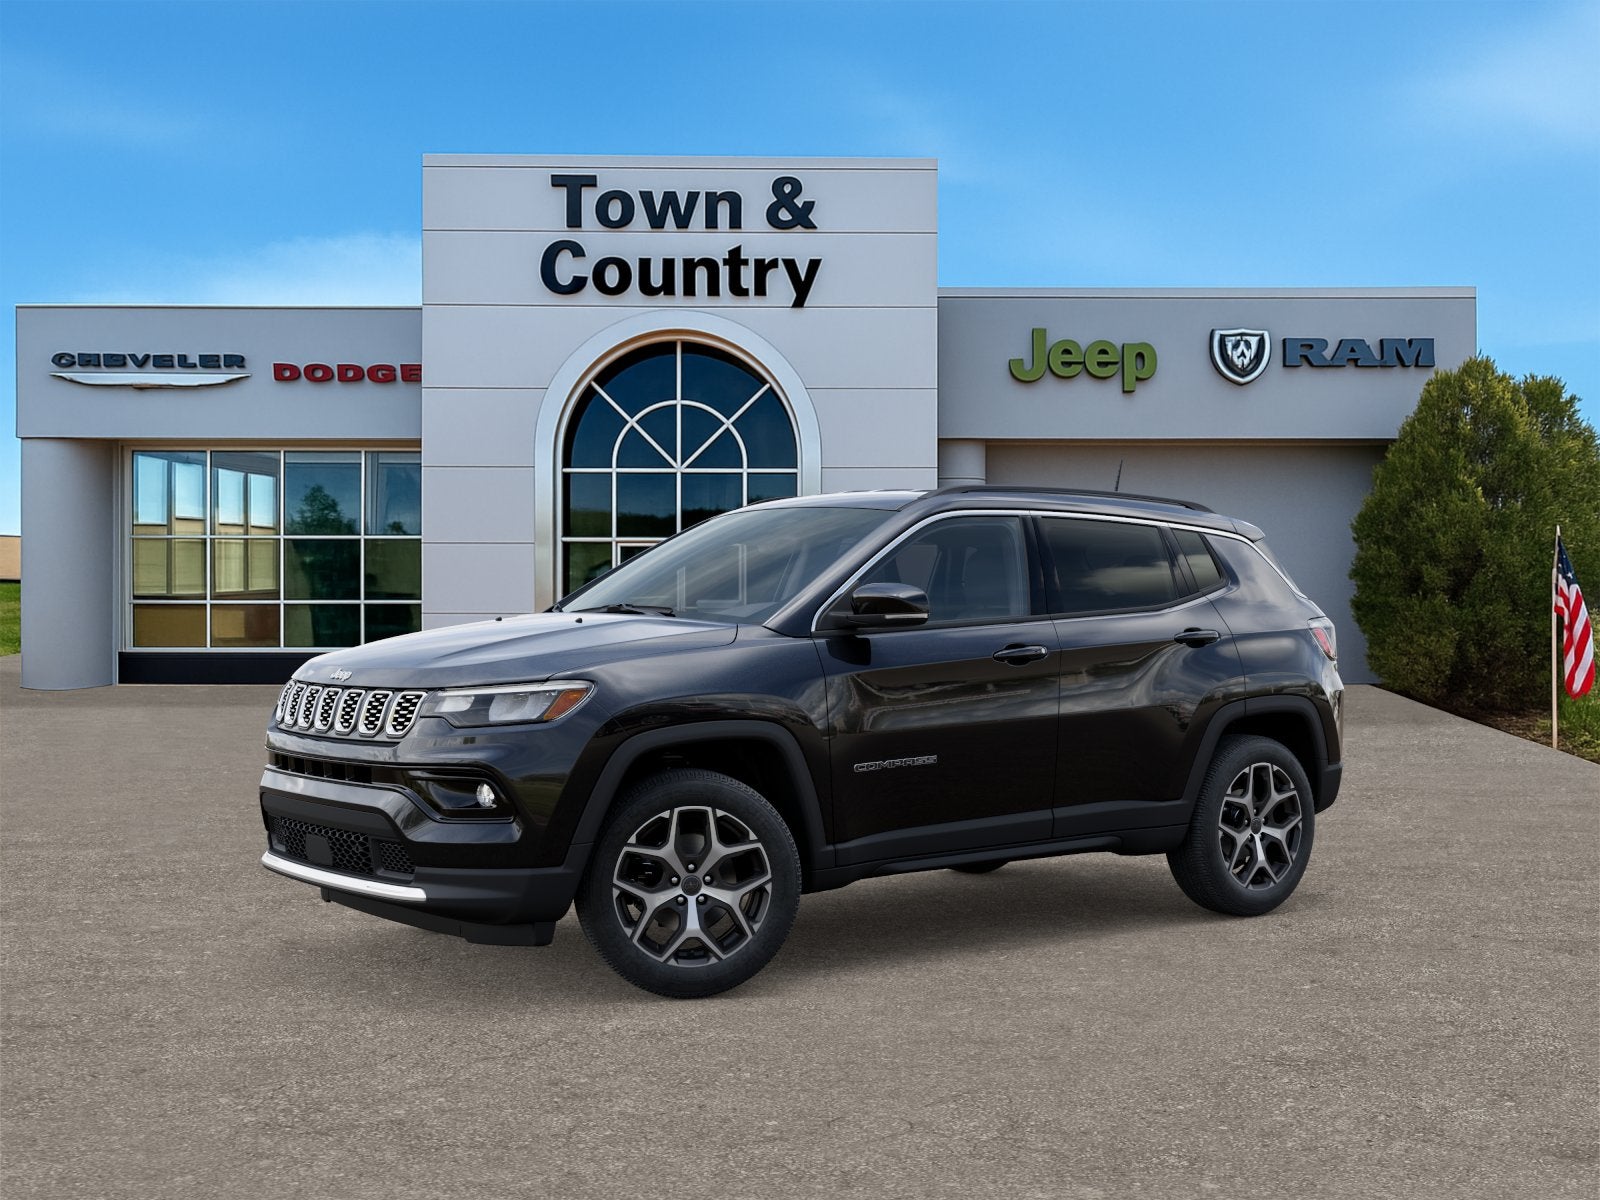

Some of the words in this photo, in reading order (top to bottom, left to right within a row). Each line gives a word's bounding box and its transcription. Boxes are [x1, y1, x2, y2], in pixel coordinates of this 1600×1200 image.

[551, 174, 742, 229] Town
[766, 176, 818, 230] &
[540, 240, 823, 308] Country
[1009, 328, 1157, 393] Jeep
[1282, 337, 1436, 368] RAM
[272, 363, 422, 383] DODGE
[330, 667, 353, 682] Jeep
[853, 755, 938, 773] COMPASS
